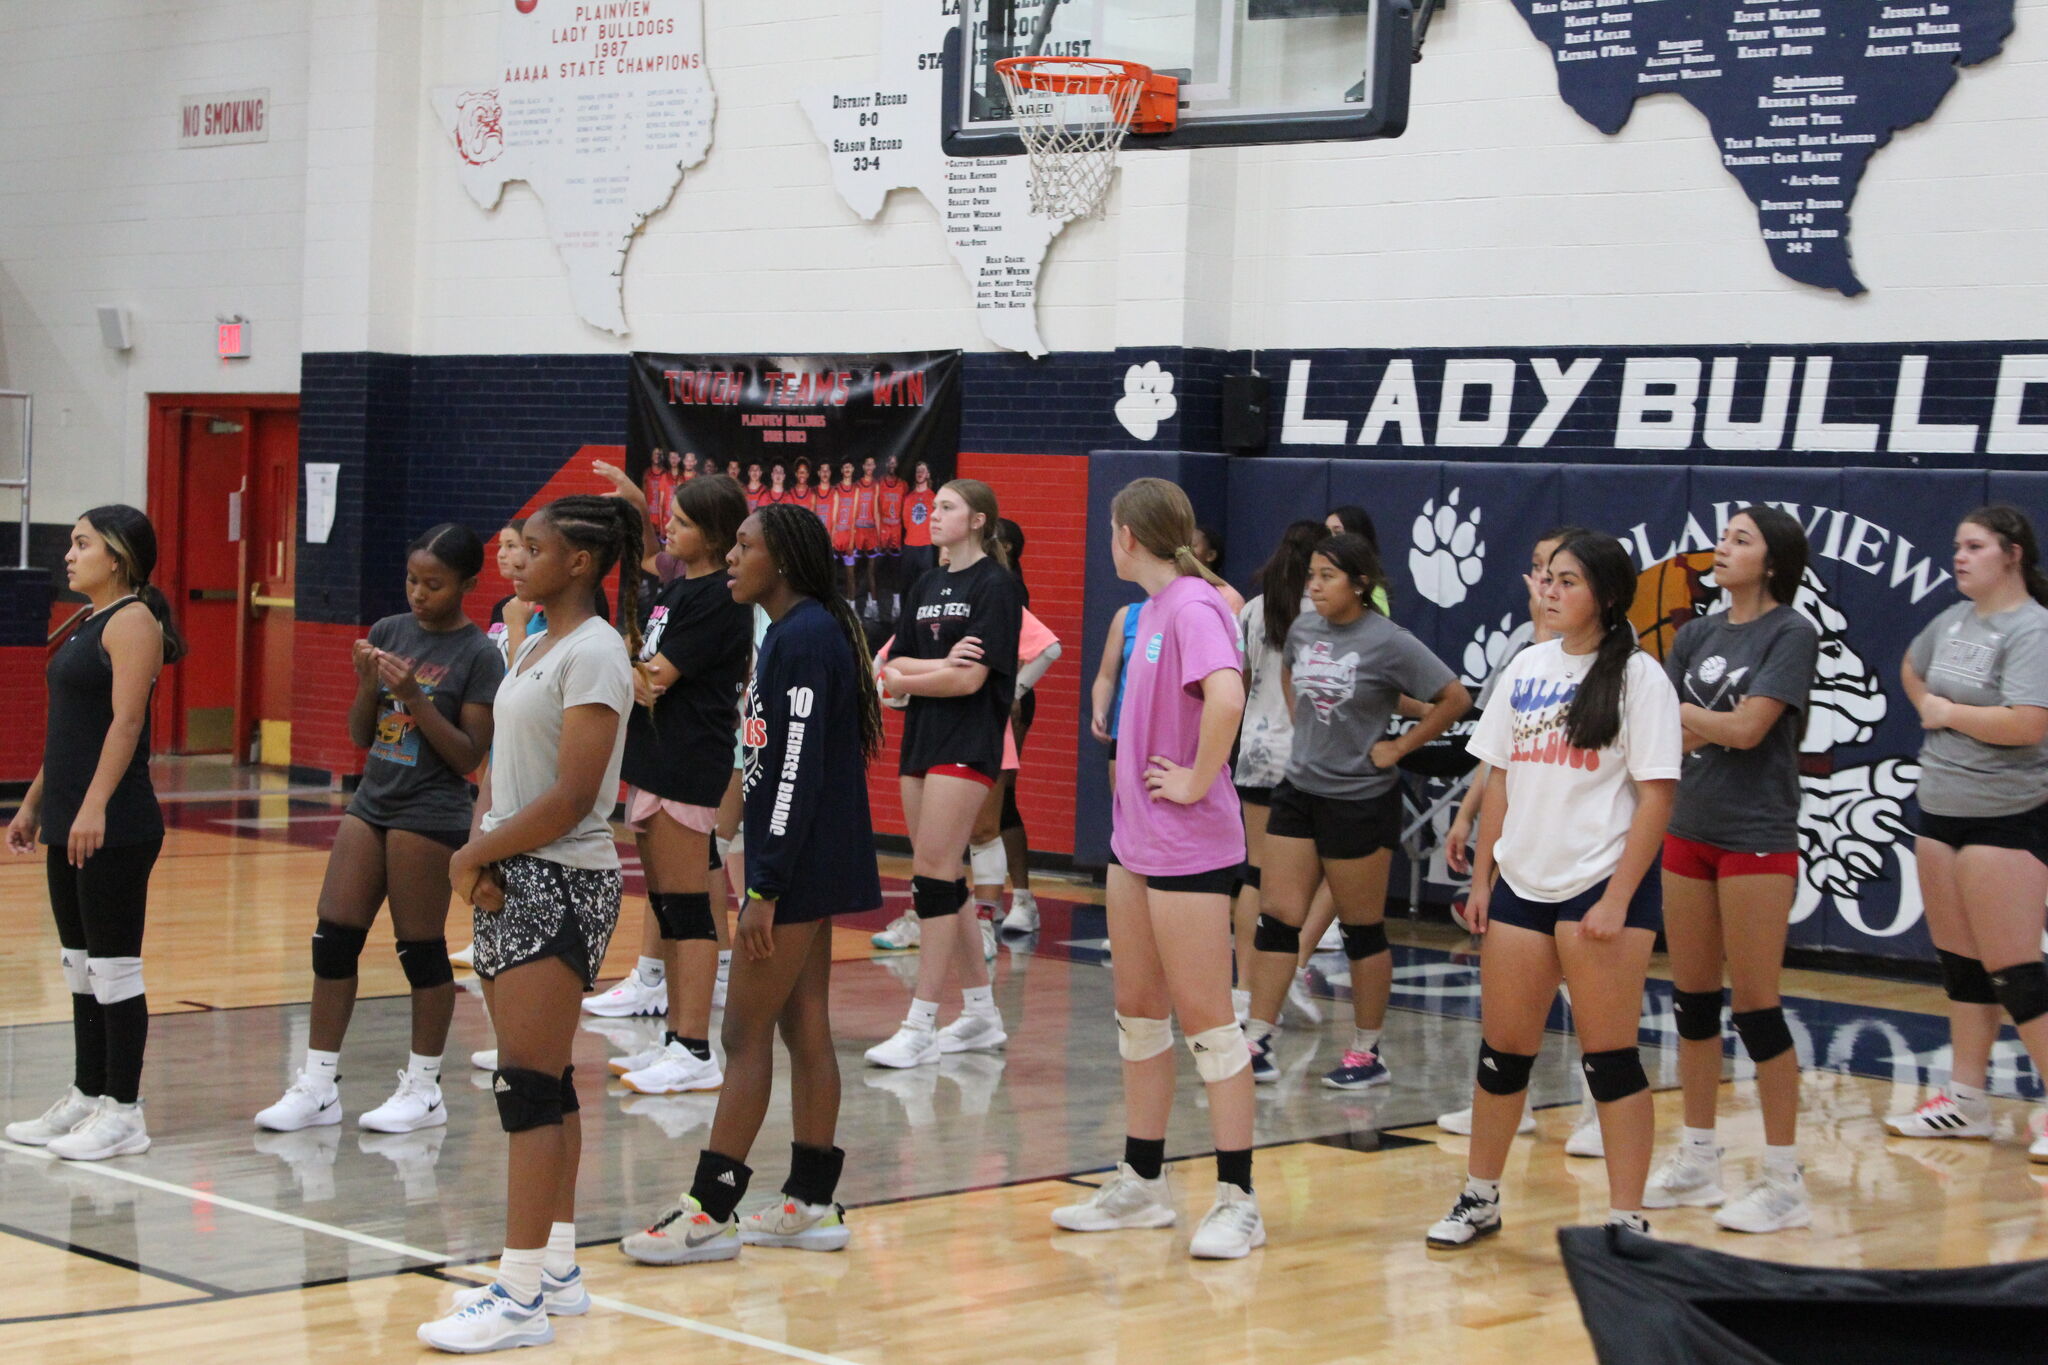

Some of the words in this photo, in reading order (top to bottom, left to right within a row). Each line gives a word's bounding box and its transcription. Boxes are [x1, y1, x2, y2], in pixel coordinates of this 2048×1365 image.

[576, 1, 651, 21] PLAINVIEW
[1532, 2, 1558, 14] HEAD
[552, 27, 588, 43] LADY
[598, 18, 675, 40] BULLDOGS
[1773, 26, 1826, 38] WILLIAMS
[594, 41, 628, 58] 1987
[1737, 46, 1778, 59] KELSEY
[1865, 44, 1908, 57] ASHLEY
[505, 65, 549, 82] AAAAA
[560, 57, 606, 78] STATE
[617, 53, 700, 74] CHAMPIONS
[1773, 75, 1844, 90] Sophomores
[833, 94, 870, 109] DISTRICT
[875, 92, 907, 106] RECORD
[183, 105, 200, 137] NO
[205, 98, 264, 135] SMOKING
[859, 112, 878, 127] 8-0
[833, 139, 866, 153] SEASON
[870, 137, 902, 151] RECORD
[1724, 137, 1752, 149] TEAM
[853, 157, 880, 171] 33-4
[1760, 200, 1804, 210] DISTRICT
[1806, 199, 1843, 209] RECORD
[1763, 229, 1799, 239] SEASON
[1801, 228, 1838, 238] RECORD
[664, 370, 744, 405] TOUGH
[764, 371, 852, 406] TEAMS
[872, 370, 927, 406] WIN
[1280, 357, 1602, 448] LADY
[943, 602, 971, 617] TECH
[786, 686, 814, 718] 10
